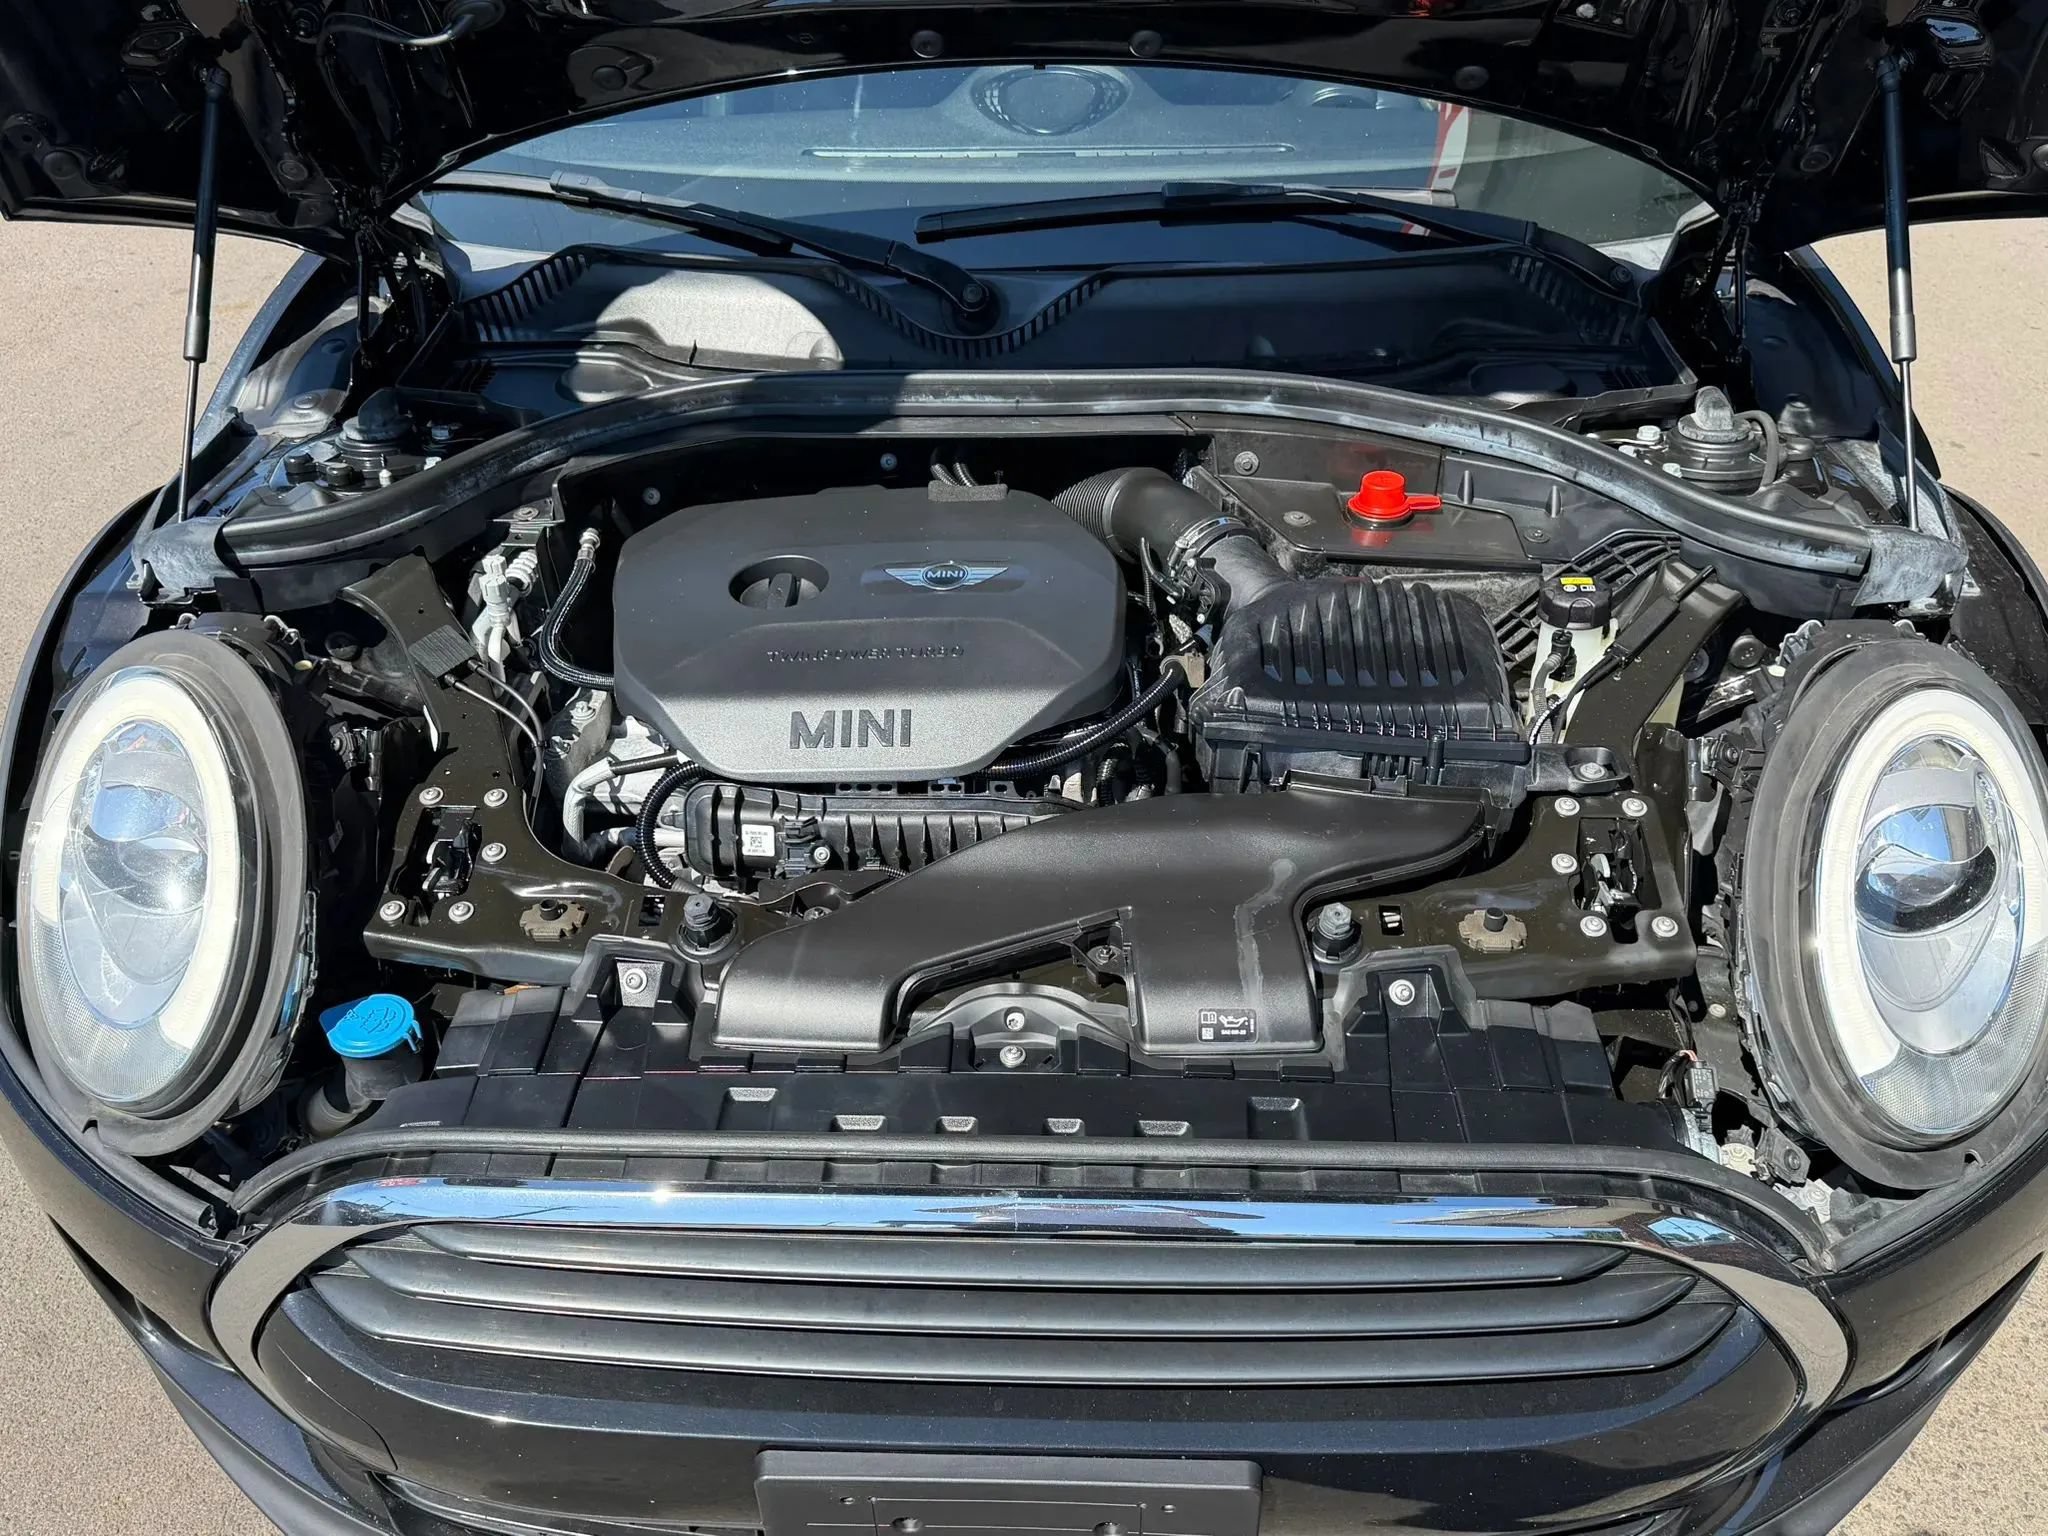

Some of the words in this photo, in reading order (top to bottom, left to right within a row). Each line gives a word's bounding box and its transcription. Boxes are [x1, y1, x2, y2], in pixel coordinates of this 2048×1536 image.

[926, 570, 964, 578] MINI
[767, 648, 890, 663] TWINPOWER
[896, 643, 965, 659] TURBO
[789, 708, 912, 750] MINI
